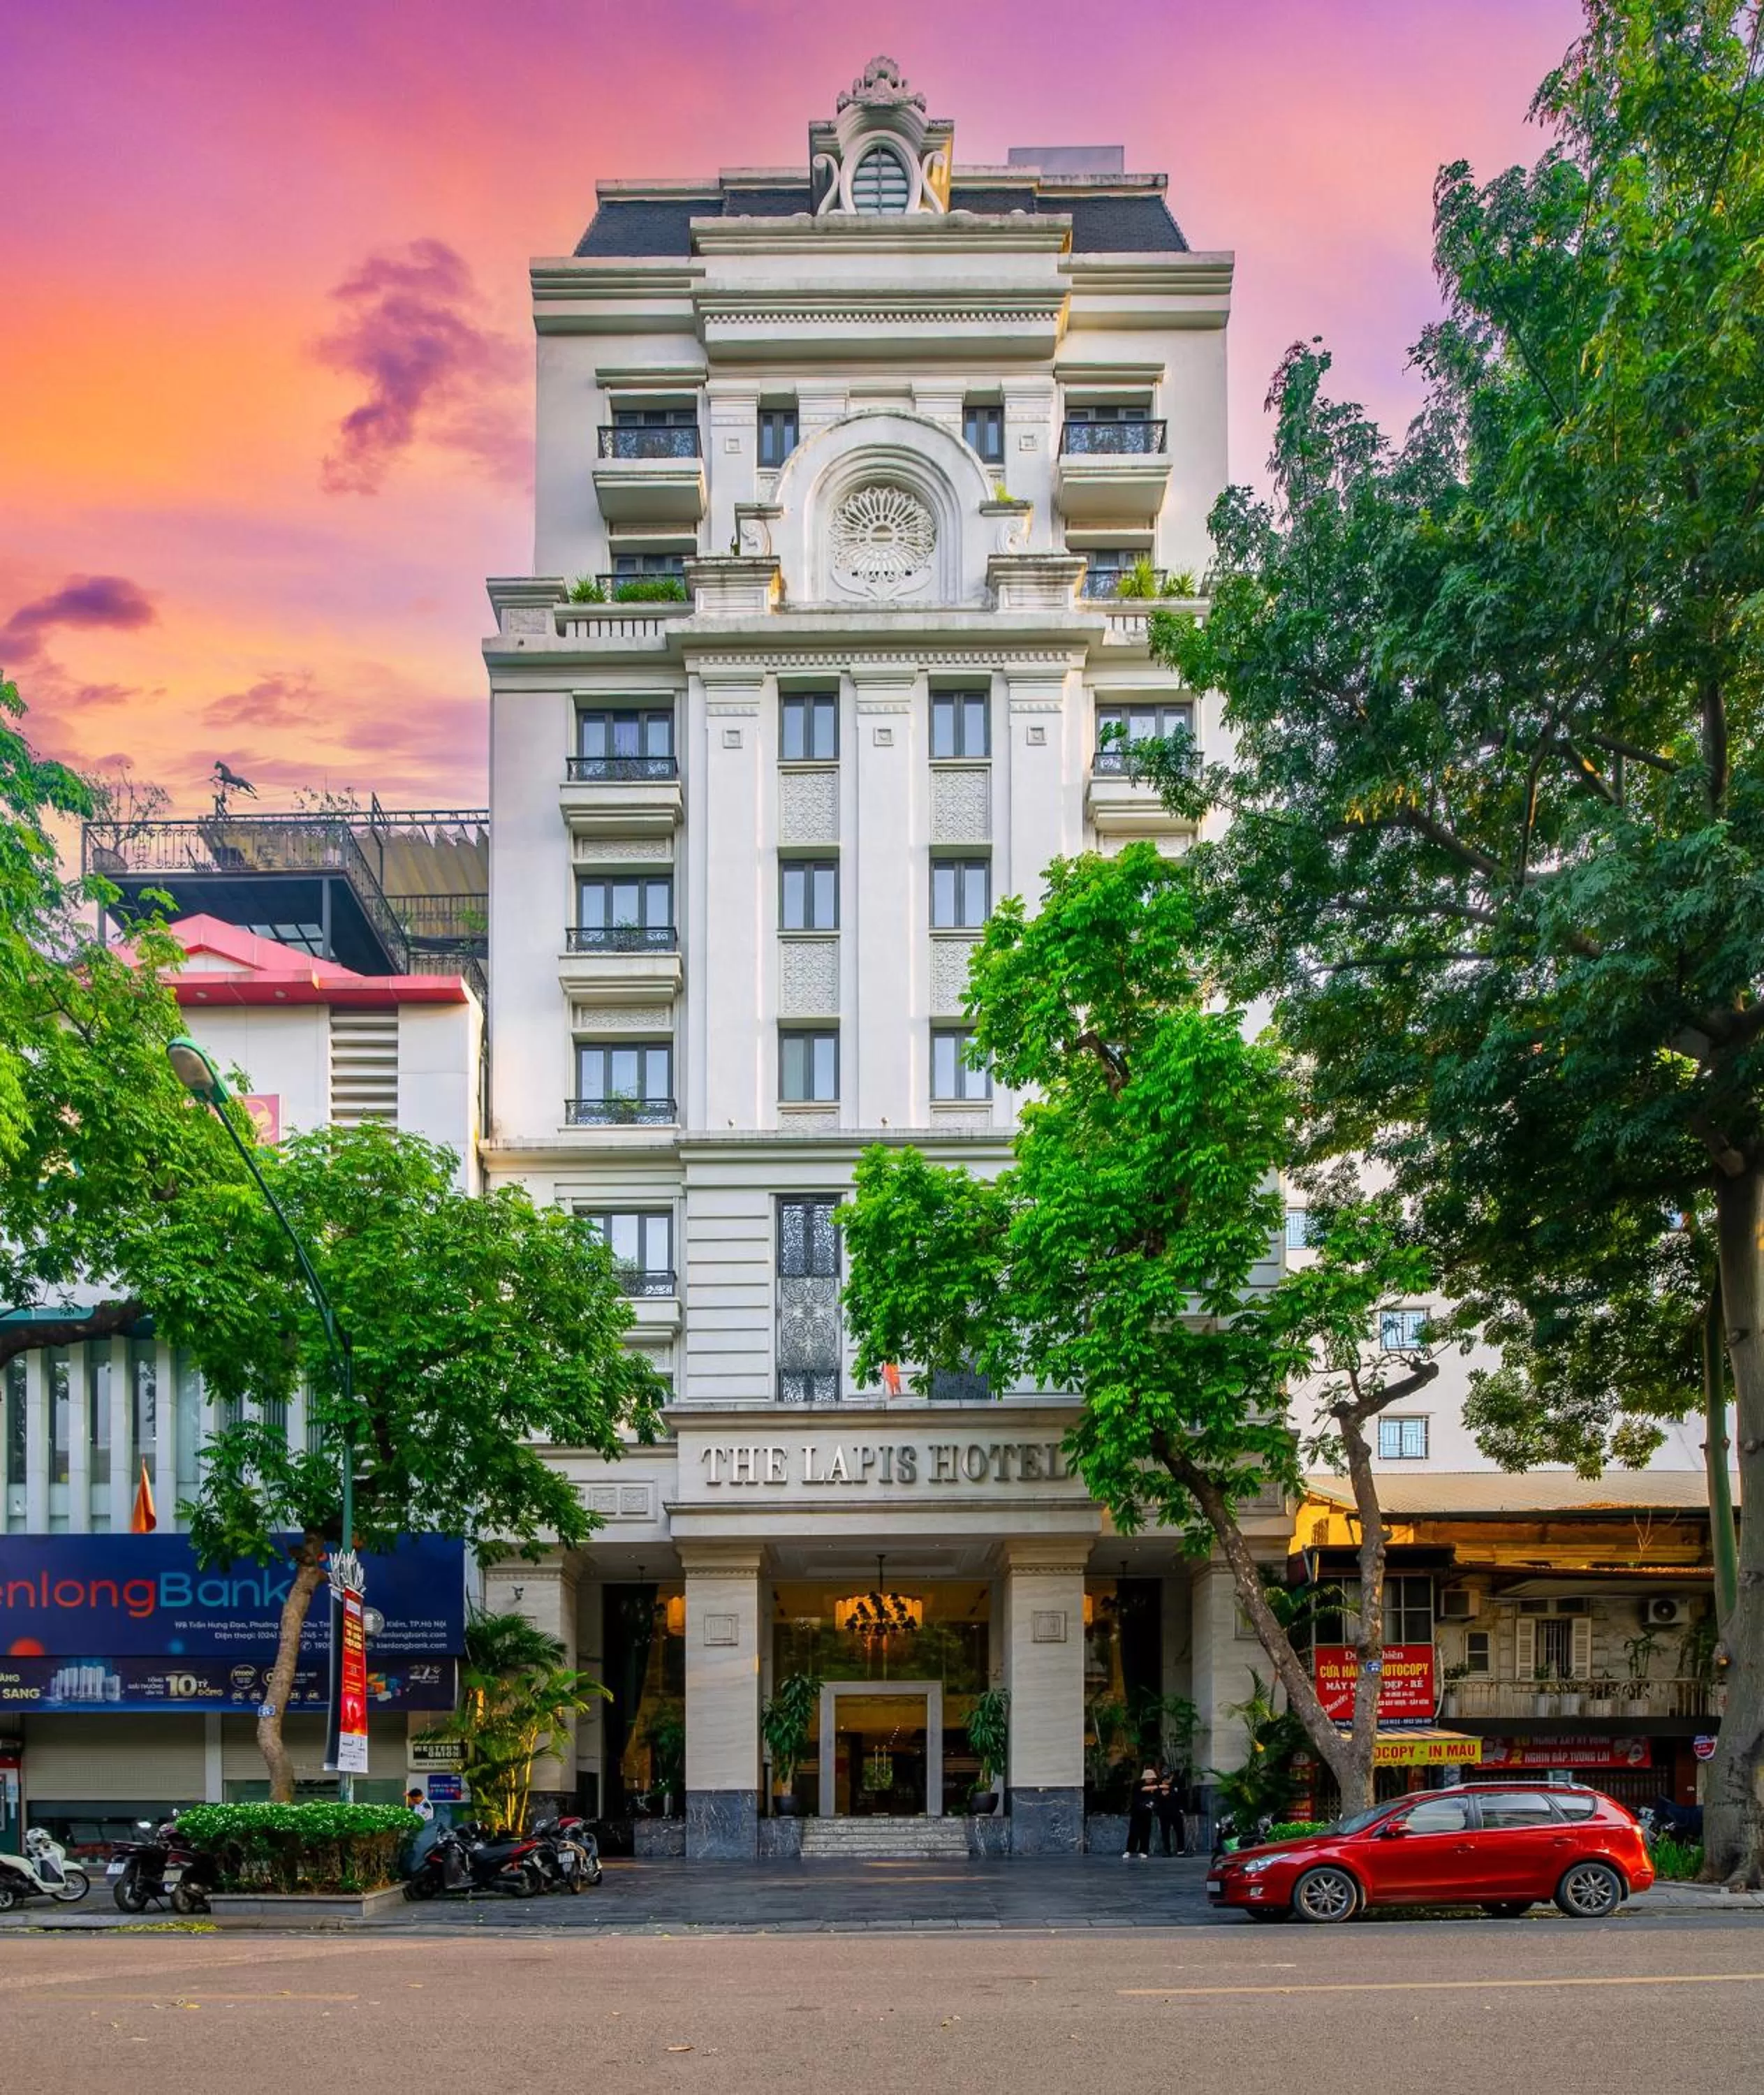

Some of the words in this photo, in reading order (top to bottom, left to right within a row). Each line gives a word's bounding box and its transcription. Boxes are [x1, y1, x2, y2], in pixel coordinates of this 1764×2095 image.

[700, 1446, 788, 1485] THE
[801, 1445, 917, 1485] LAPIS
[927, 1442, 1070, 1483] HOTEL
[0, 1571, 293, 1618] nlongBank
[1381, 1663, 1429, 1677] OTOCOPY
[2, 1688, 41, 1699] SANG
[166, 1675, 197, 1697] 10
[1374, 1746, 1415, 1759] OCOPY
